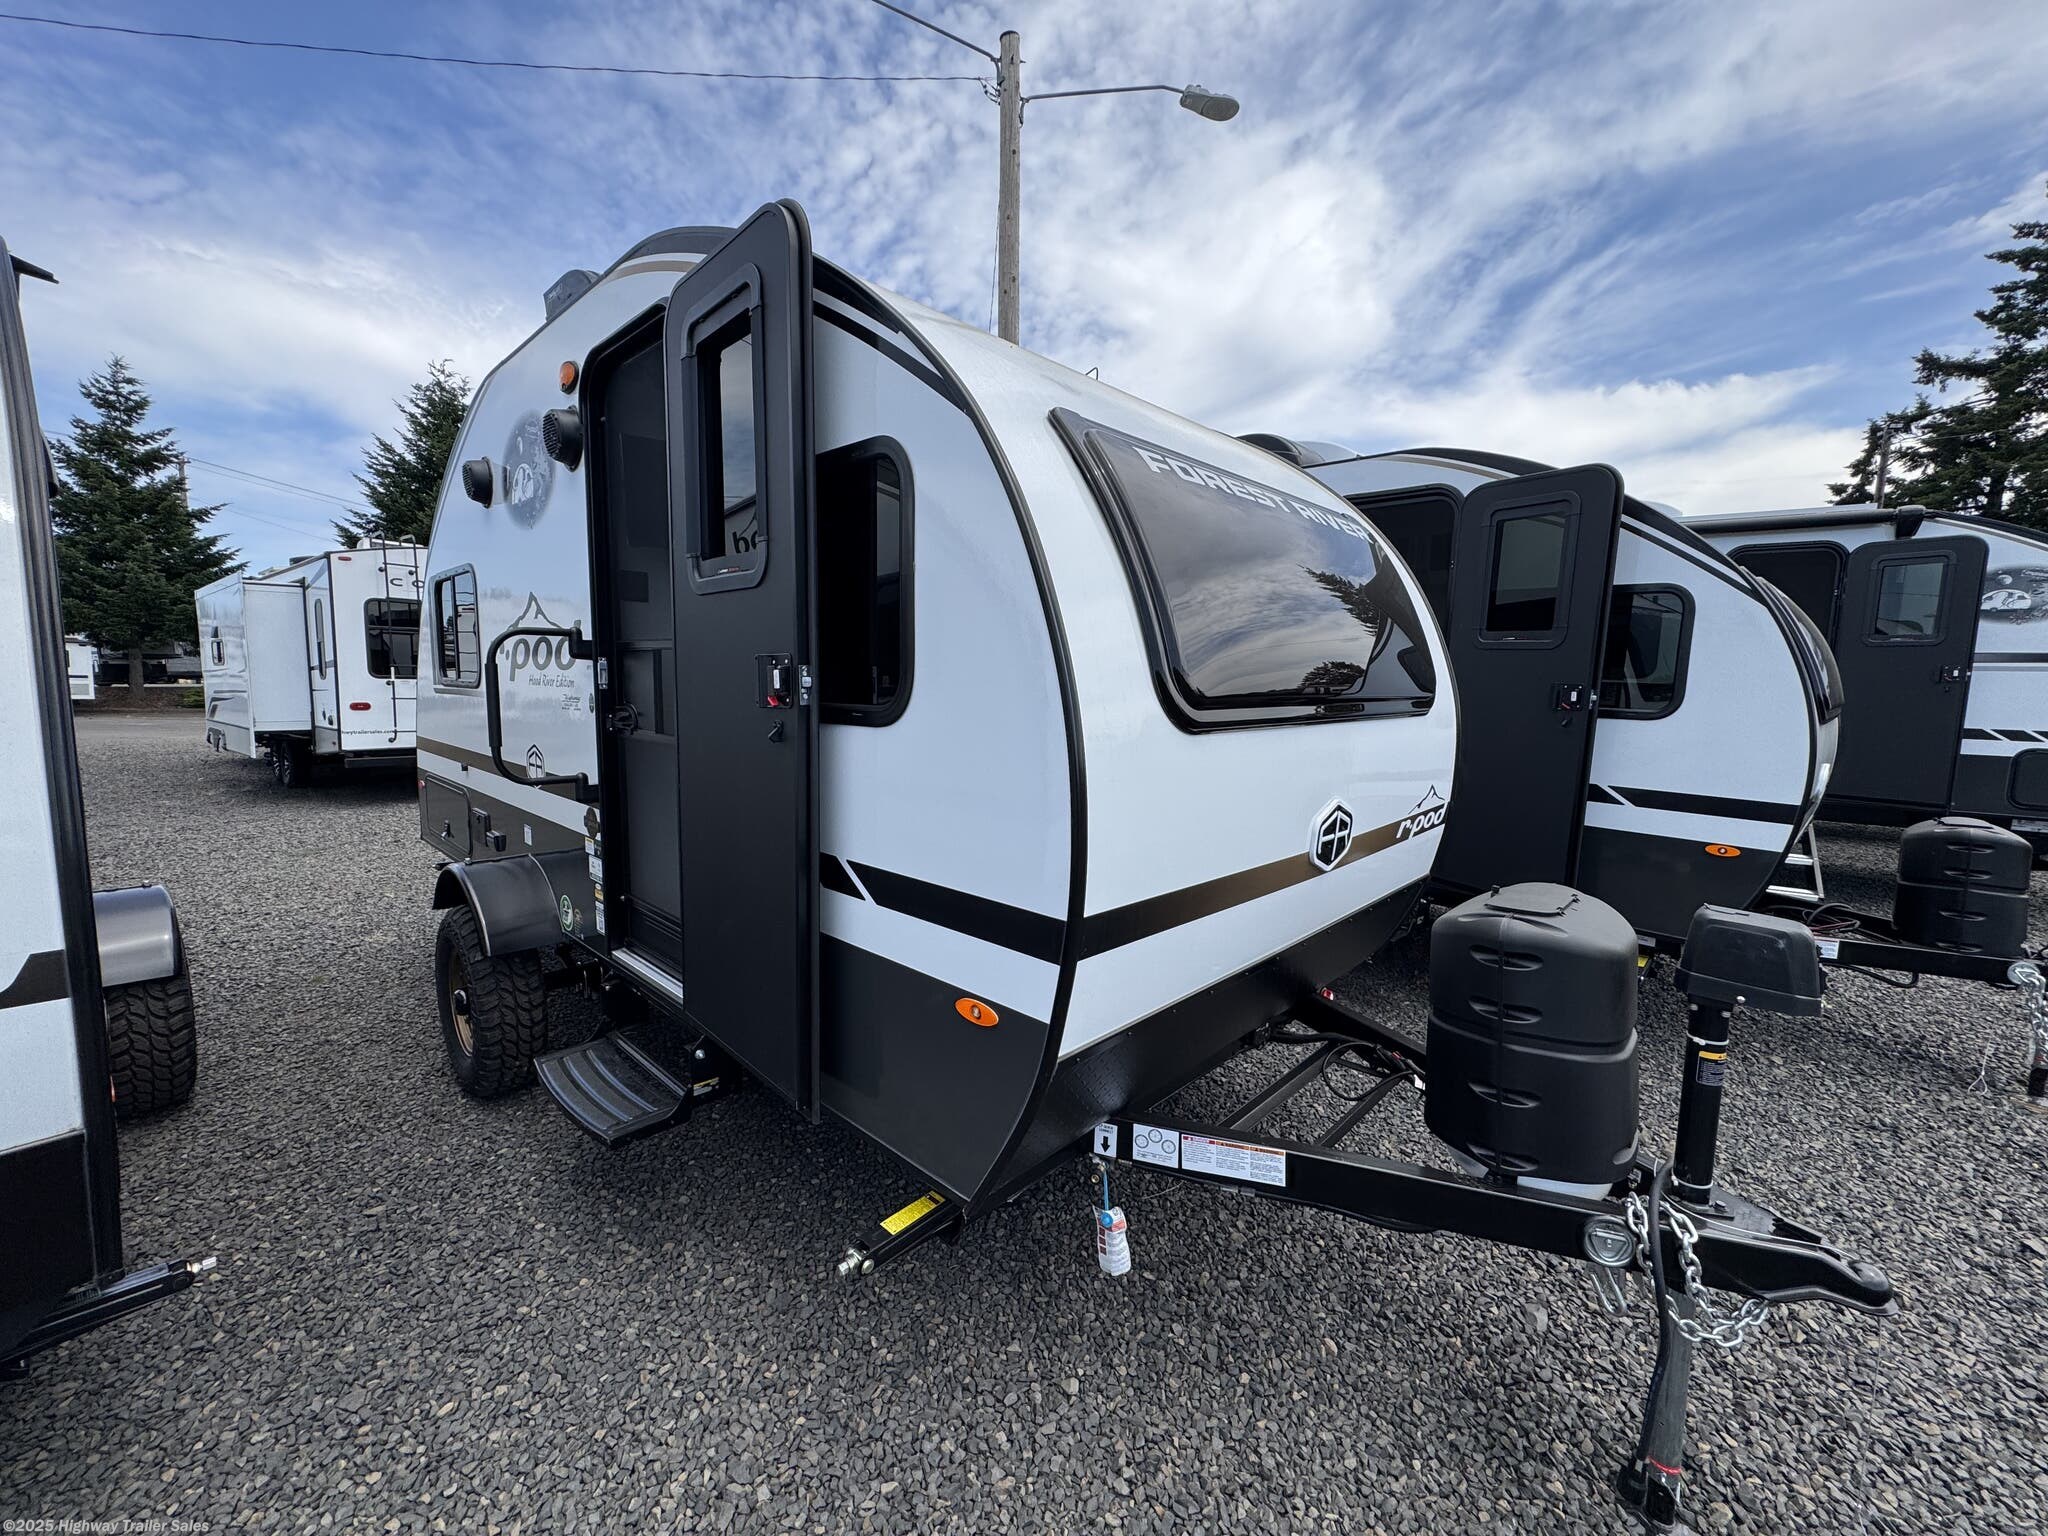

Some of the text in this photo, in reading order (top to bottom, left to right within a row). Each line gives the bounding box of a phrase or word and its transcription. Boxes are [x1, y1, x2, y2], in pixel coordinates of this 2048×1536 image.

[1133, 446, 1374, 544] FOREST RIVER
[528, 673, 575, 688] Hood River Edition
